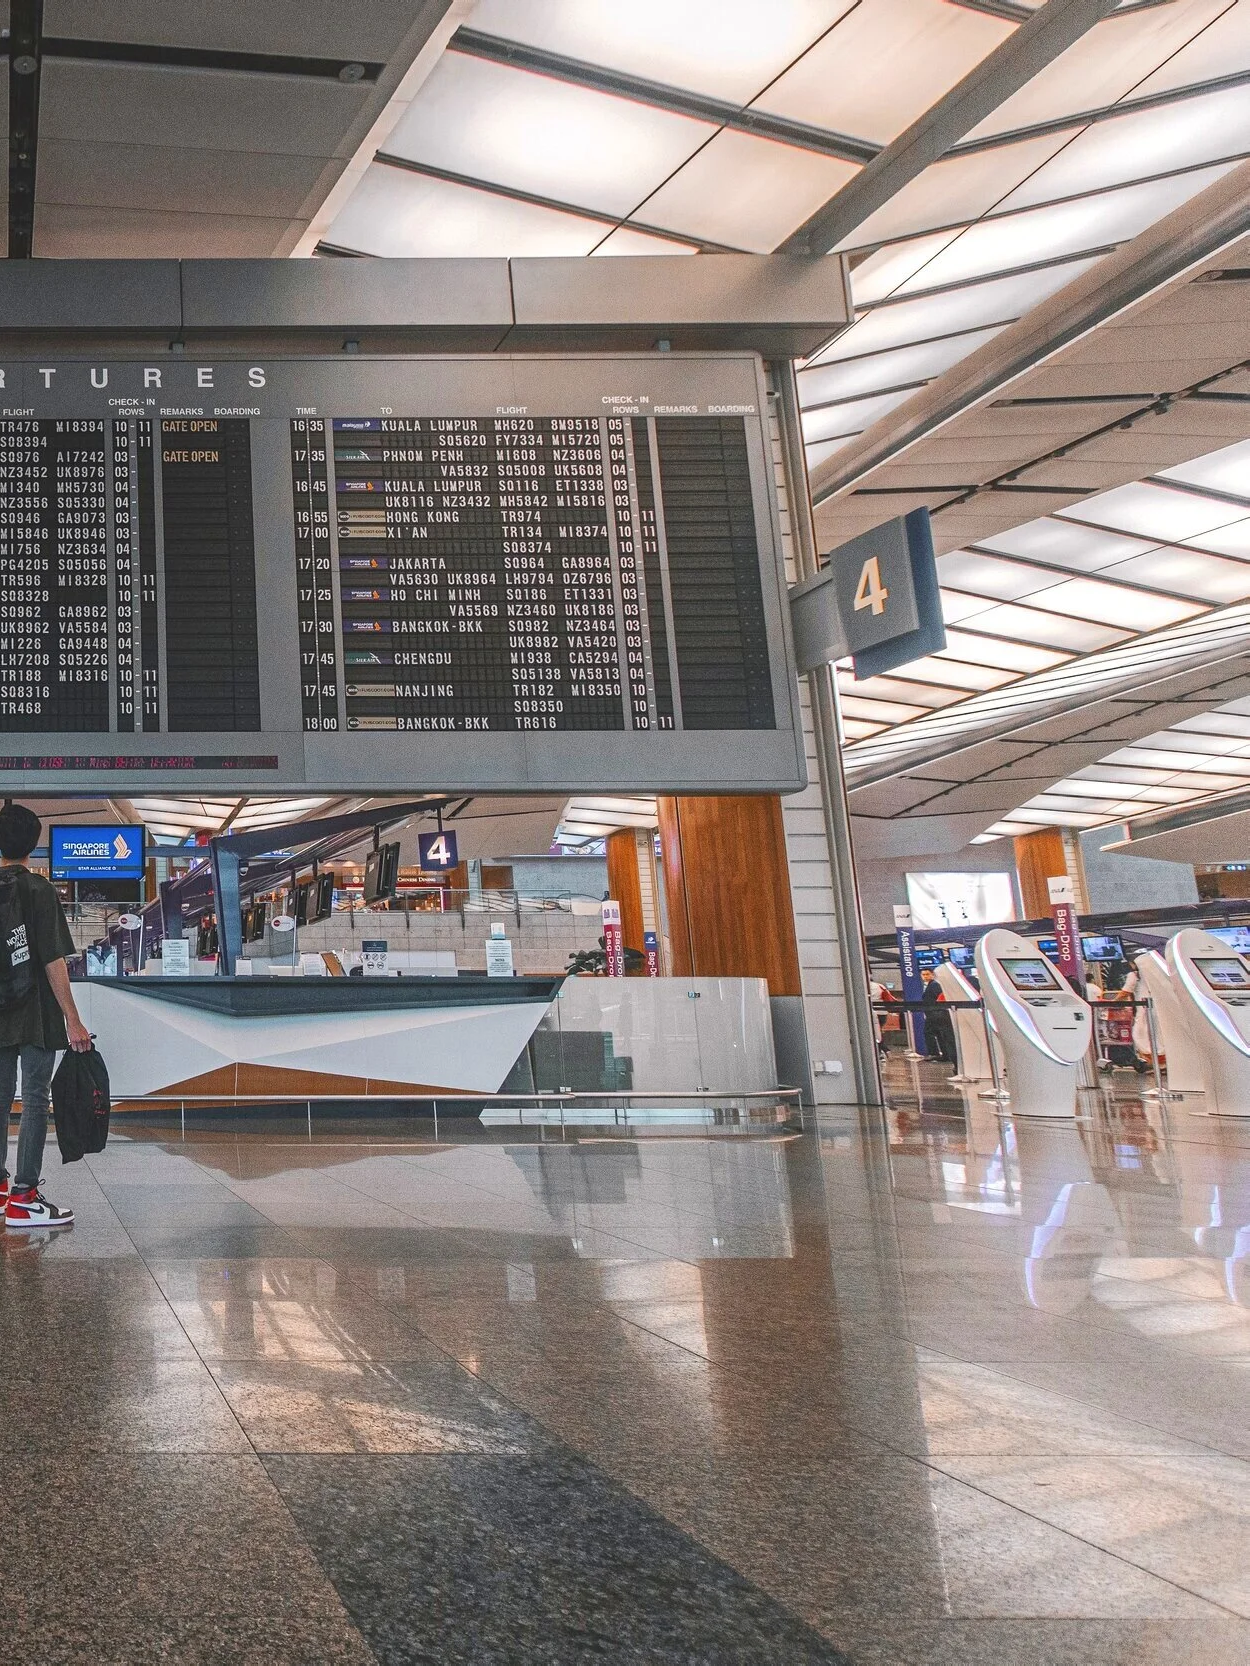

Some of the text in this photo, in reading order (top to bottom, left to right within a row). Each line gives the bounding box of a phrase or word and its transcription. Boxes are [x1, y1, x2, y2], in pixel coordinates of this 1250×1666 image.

[3, 408, 34, 416] FLIGHT
[118, 408, 145, 416] ROWS
[160, 408, 203, 416] REMARKS
[214, 408, 260, 416] BOARDING
[0, 421, 40, 433] TR476
[57, 421, 104, 433] MI8394
[162, 421, 188, 432] GATE
[190, 421, 218, 432] OPEN
[382, 420, 422, 432] KUALA
[431, 420, 478, 431] LUMPUR
[495, 419, 534, 431] MH620
[551, 419, 599, 431] 8M9518
[163, 451, 188, 462] GATE
[191, 451, 219, 462] OPEN
[383, 449, 464, 462] PHNOM PENH
[0, 466, 48, 478] NZ3452
[57, 466, 105, 478] UK8976
[441, 464, 603, 477] VA5832 SQ5008 UK5608
[385, 480, 482, 493] KUALA LUMPUR
[1, 512, 41, 524] SQ946
[58, 511, 106, 524] GA9073
[387, 511, 419, 523] HONG
[427, 510, 460, 523] KONG
[388, 526, 428, 539] XI'AN
[1, 558, 49, 571] PG4205
[59, 558, 107, 571] SQ5056
[390, 557, 447, 570] JAKARTA
[390, 572, 612, 586] VA5630 UK8964 LH9794 OZ6796
[854, 556, 889, 616] 4
[391, 588, 481, 602] HO CHI MINH
[1, 605, 41, 618] SQ962
[59, 605, 107, 618] GA8962
[393, 620, 483, 633] BANGKOK-BKK
[395, 652, 452, 665] CHENGDU
[512, 667, 619, 681] SQ5138 VA5813
[396, 684, 454, 697] NANJING
[398, 716, 490, 730] BANGKOK-BKK
[515, 716, 557, 729] TR616
[62, 842, 110, 850] SINGAPORE
[426, 835, 451, 865] 4
[1056, 909, 1071, 962] Bag-Drop
[900, 930, 914, 977] Assistance
